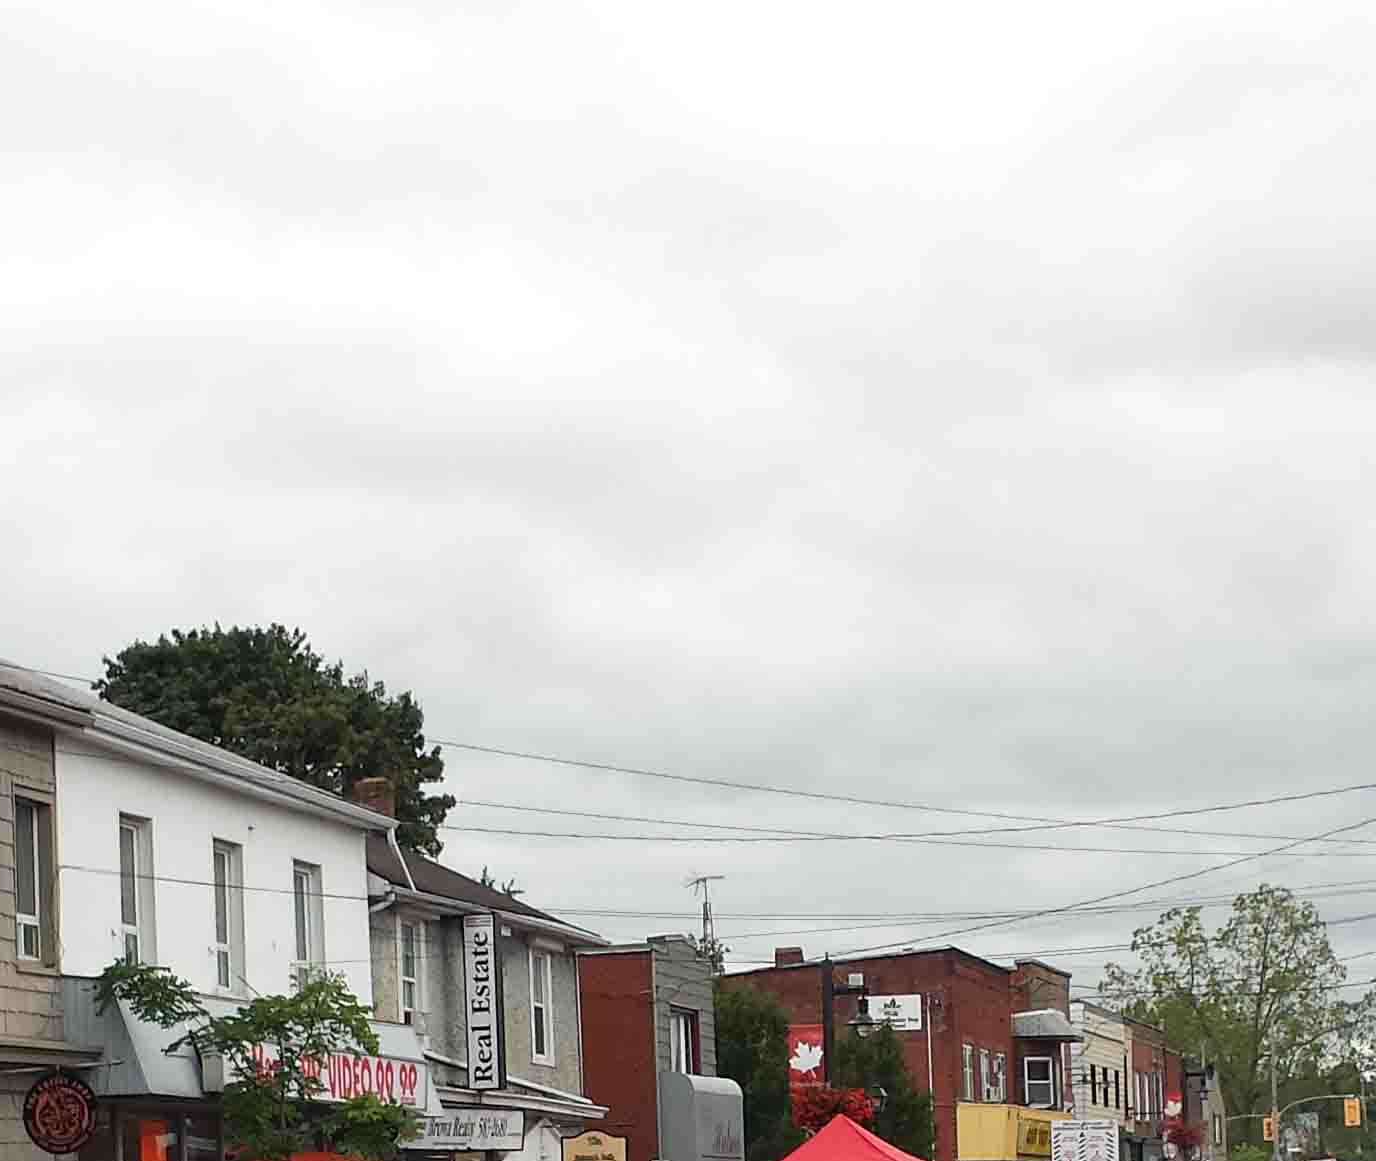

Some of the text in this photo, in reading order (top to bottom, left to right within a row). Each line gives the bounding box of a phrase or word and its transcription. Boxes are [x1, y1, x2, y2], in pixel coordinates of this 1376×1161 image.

[472, 931, 493, 1082] Real Estate
[328, 1055, 372, 1099] VIDEO
